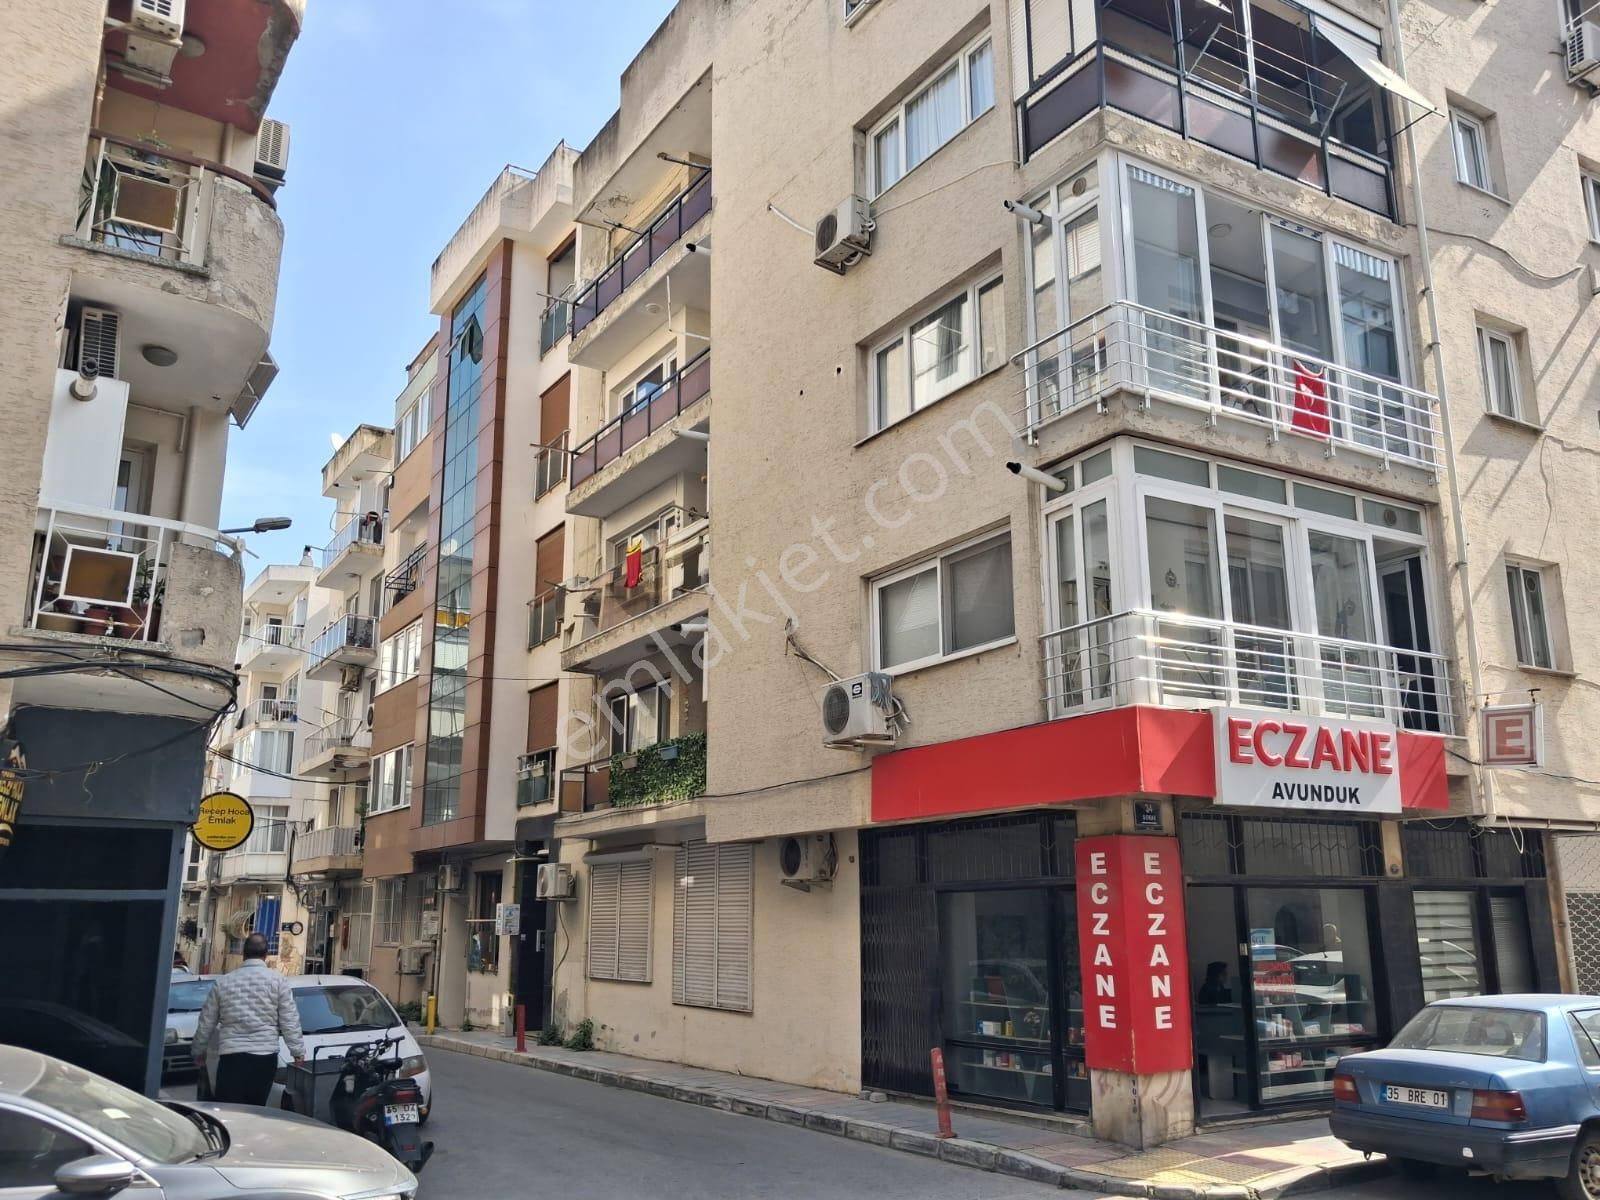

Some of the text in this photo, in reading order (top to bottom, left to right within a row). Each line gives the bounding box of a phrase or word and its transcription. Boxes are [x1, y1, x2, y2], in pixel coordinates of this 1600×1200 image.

[1228, 715, 1393, 775] ECZANE
[1495, 719, 1525, 756] E
[1272, 782, 1361, 805] AVUNDUK
[208, 816, 237, 825] Emlak
[228, 807, 250, 816] Hoca
[1090, 852, 1117, 1029] ECZANE
[1143, 852, 1173, 1030] ECZANE
[1388, 1087, 1445, 1105] 35 BRE 01
